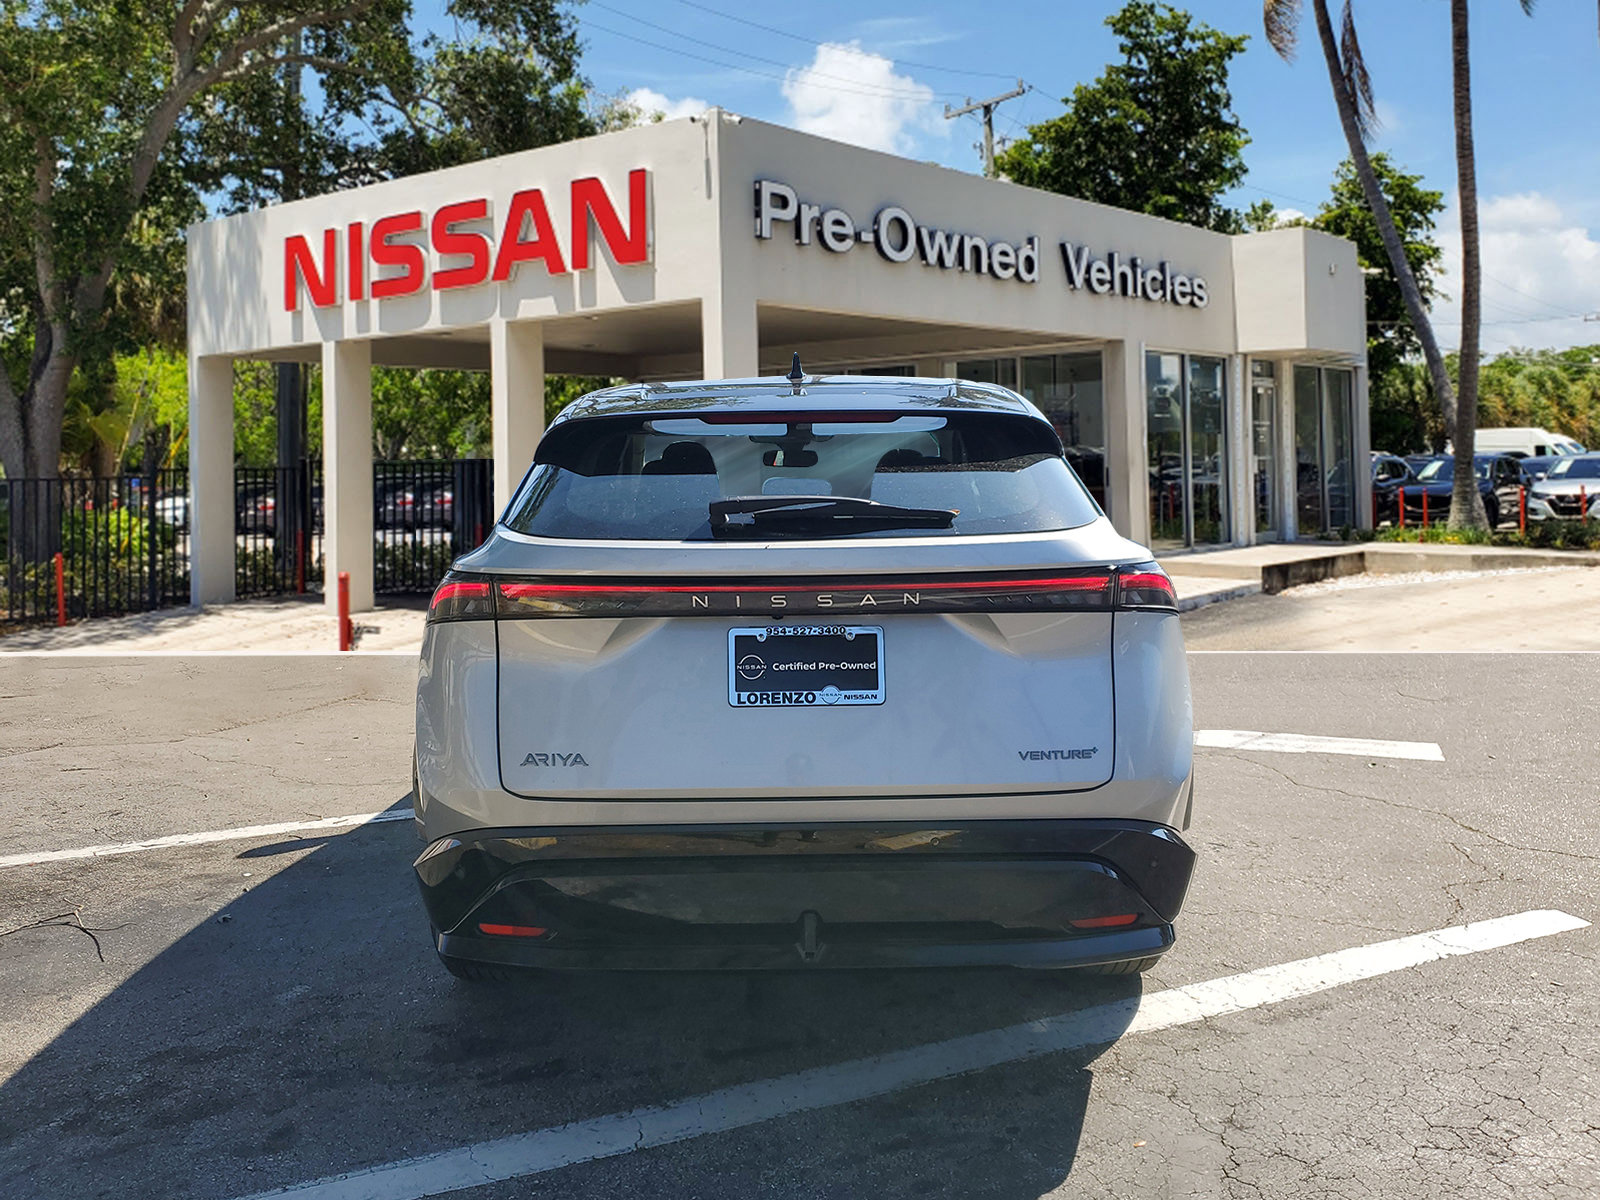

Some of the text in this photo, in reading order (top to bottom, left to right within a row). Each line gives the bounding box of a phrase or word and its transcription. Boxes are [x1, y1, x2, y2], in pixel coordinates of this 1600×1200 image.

[285, 169, 647, 312] NISSAN
[754, 180, 1209, 308] Pre-Owned Vehicles
[692, 593, 920, 608] NISSAN
[765, 626, 847, 636] 954-527-3400
[772, 661, 877, 671] Certified Pre-Owned
[737, 692, 817, 705] LORENZO
[519, 752, 589, 767] ARIYA
